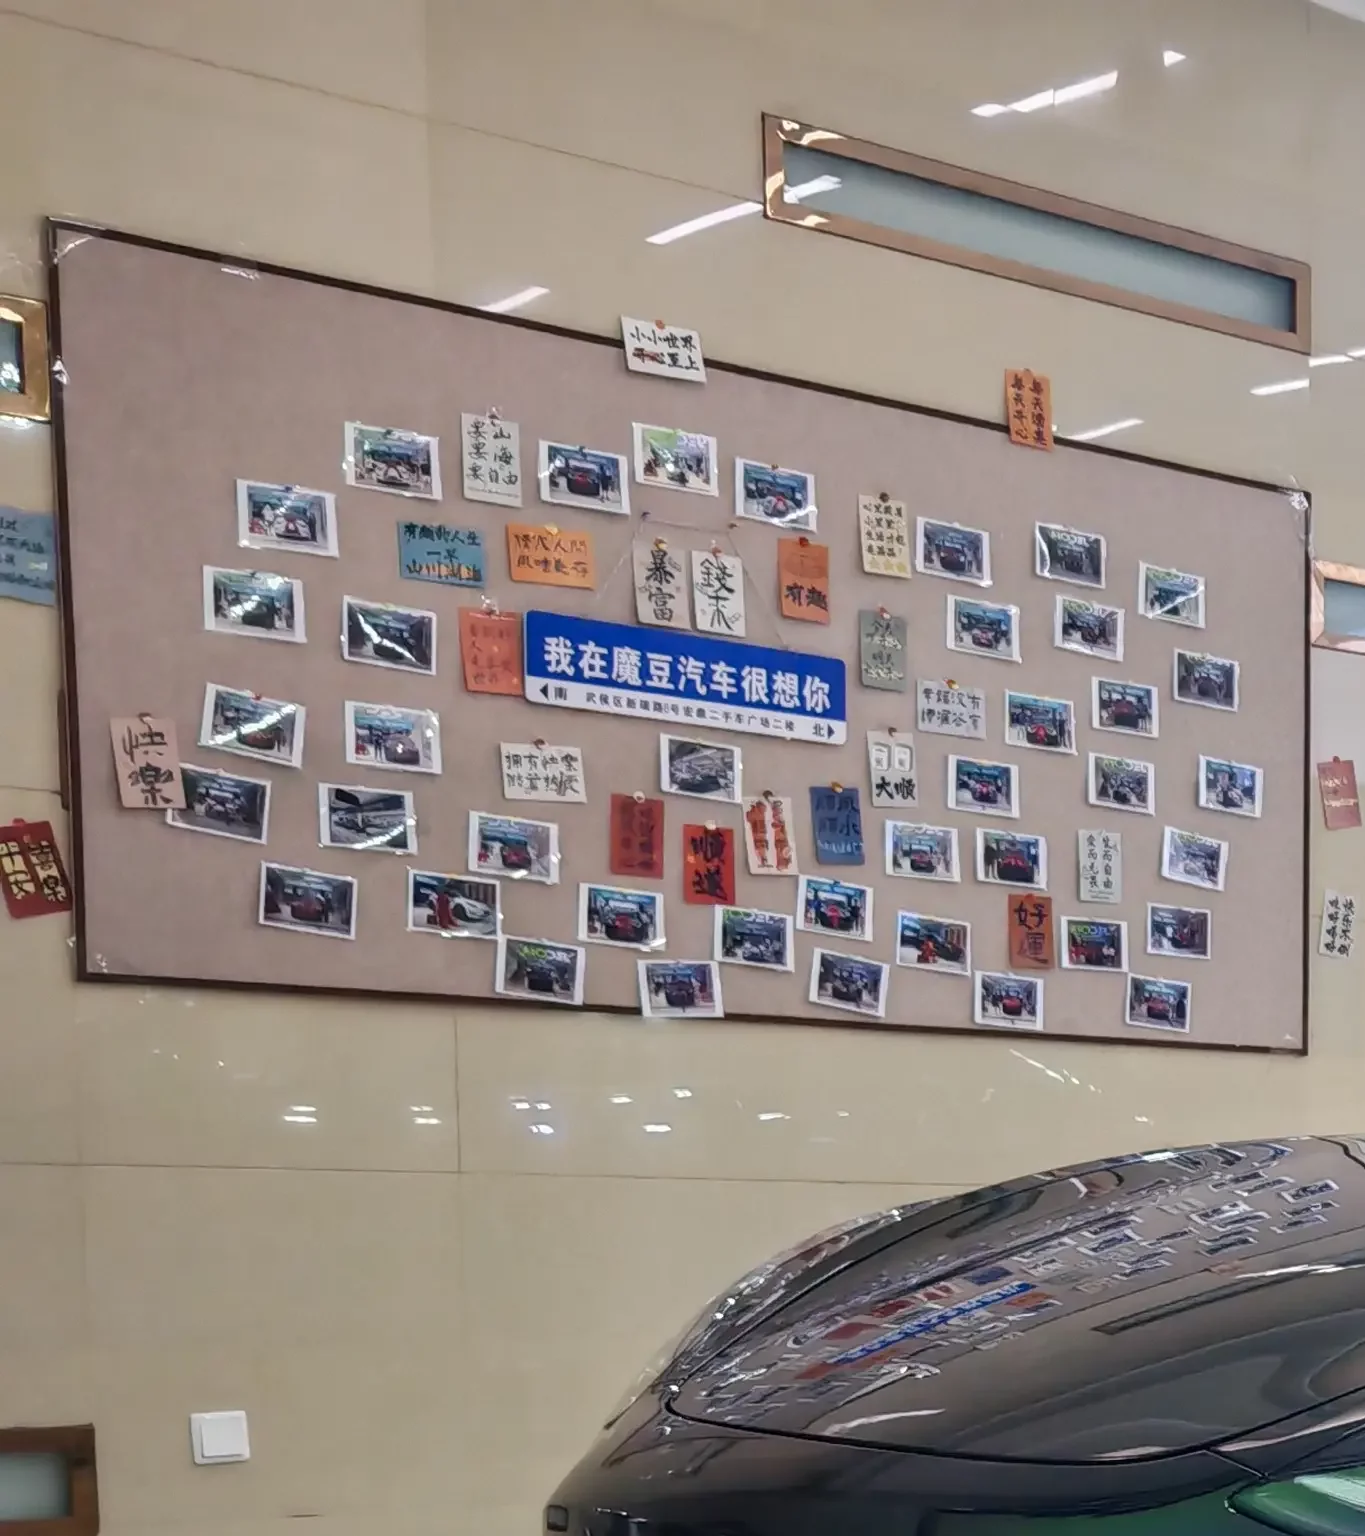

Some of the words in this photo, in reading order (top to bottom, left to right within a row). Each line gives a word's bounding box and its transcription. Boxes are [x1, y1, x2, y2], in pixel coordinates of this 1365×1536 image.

[543, 635, 832, 715] 我在魔豆汽车很想你
[812, 721, 826, 738] 北
